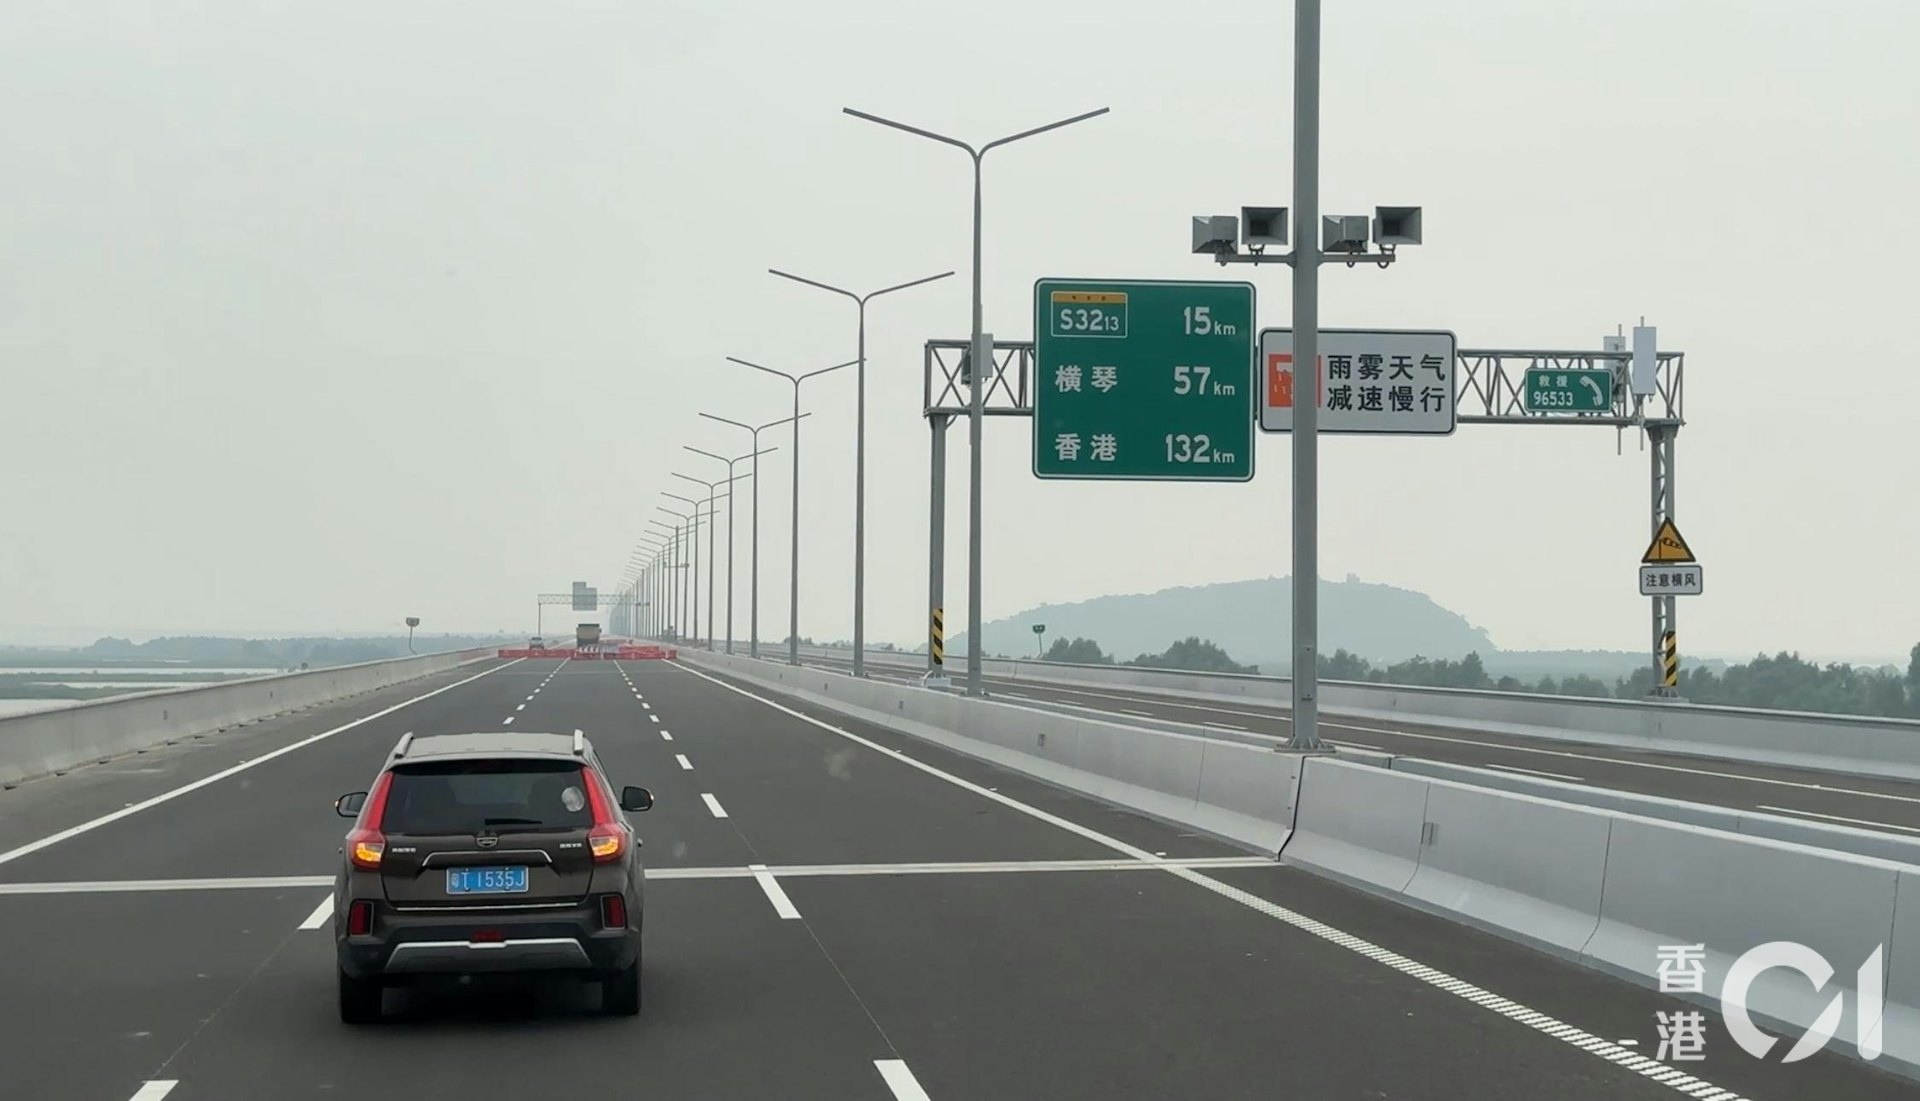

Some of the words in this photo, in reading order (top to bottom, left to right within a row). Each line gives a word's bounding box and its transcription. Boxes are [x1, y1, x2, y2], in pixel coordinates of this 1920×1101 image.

[1060, 308, 1119, 331] S3213
[1055, 365, 1118, 393] 横琴
[1327, 354, 1446, 381] 雨雾天气
[1327, 385, 1446, 412] 减速慢行
[1533, 391, 1573, 406] 96533
[1055, 433, 1118, 461] 香港
[1646, 573, 1696, 587] 注意横风
